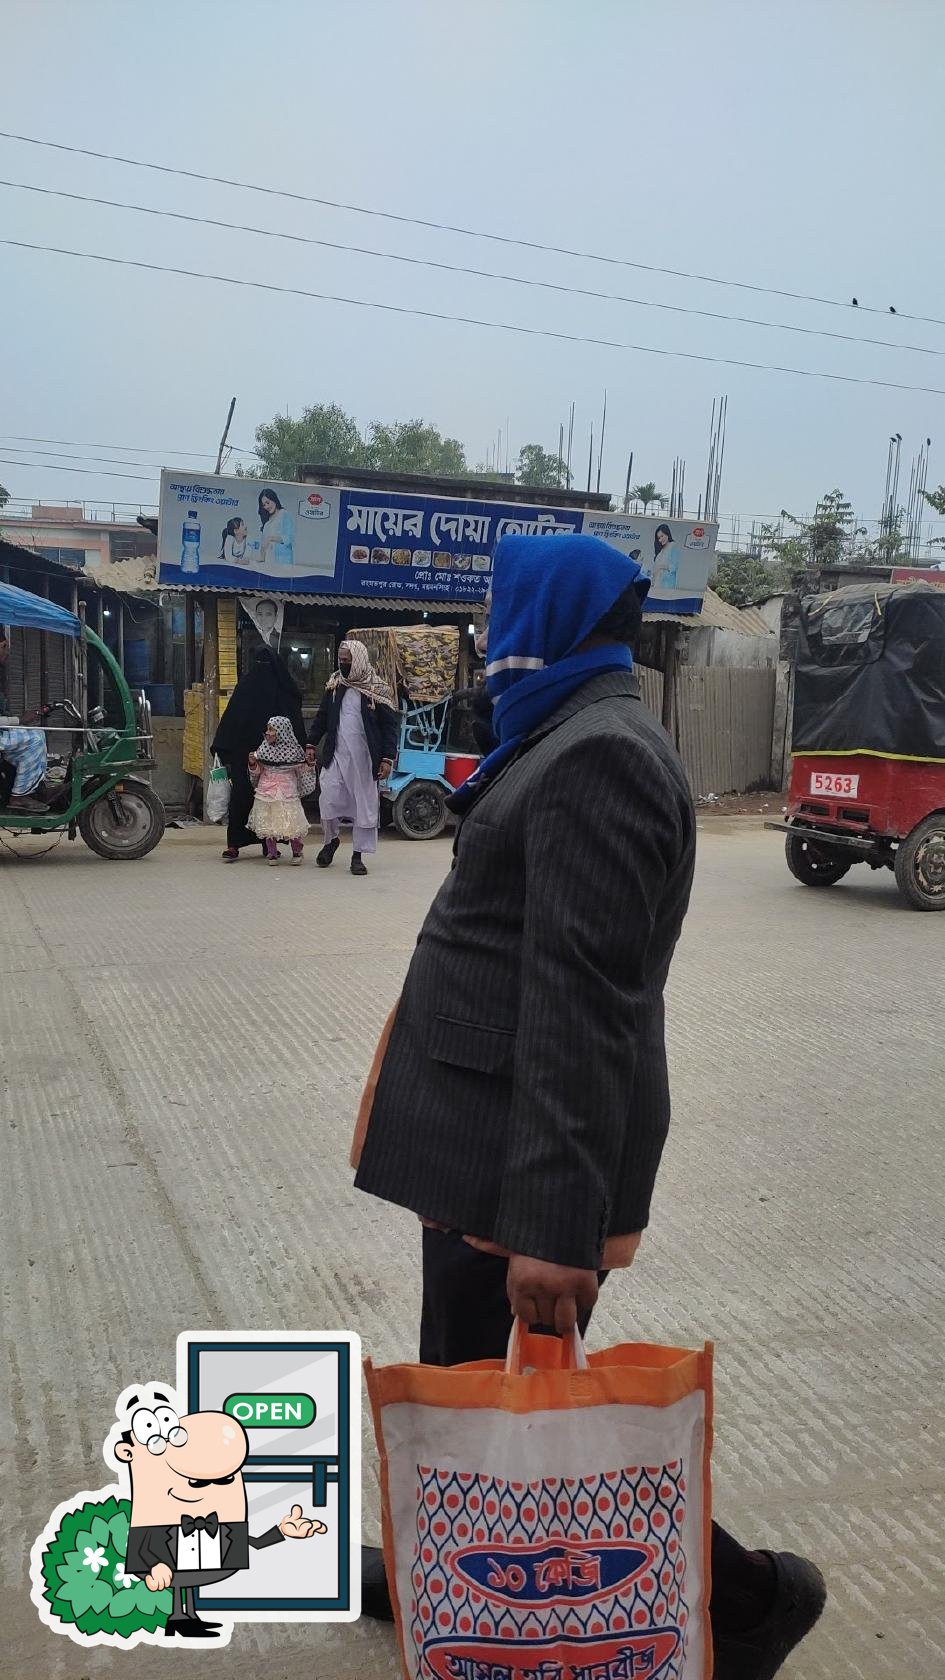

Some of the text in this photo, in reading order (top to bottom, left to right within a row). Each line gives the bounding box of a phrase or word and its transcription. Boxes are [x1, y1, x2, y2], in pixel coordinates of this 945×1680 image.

[347, 505, 424, 543] মায়ের
[430, 513, 491, 546] দোয়া
[815, 774, 852, 793] 5263
[487, 1549, 601, 1592] ১০ কেজি
